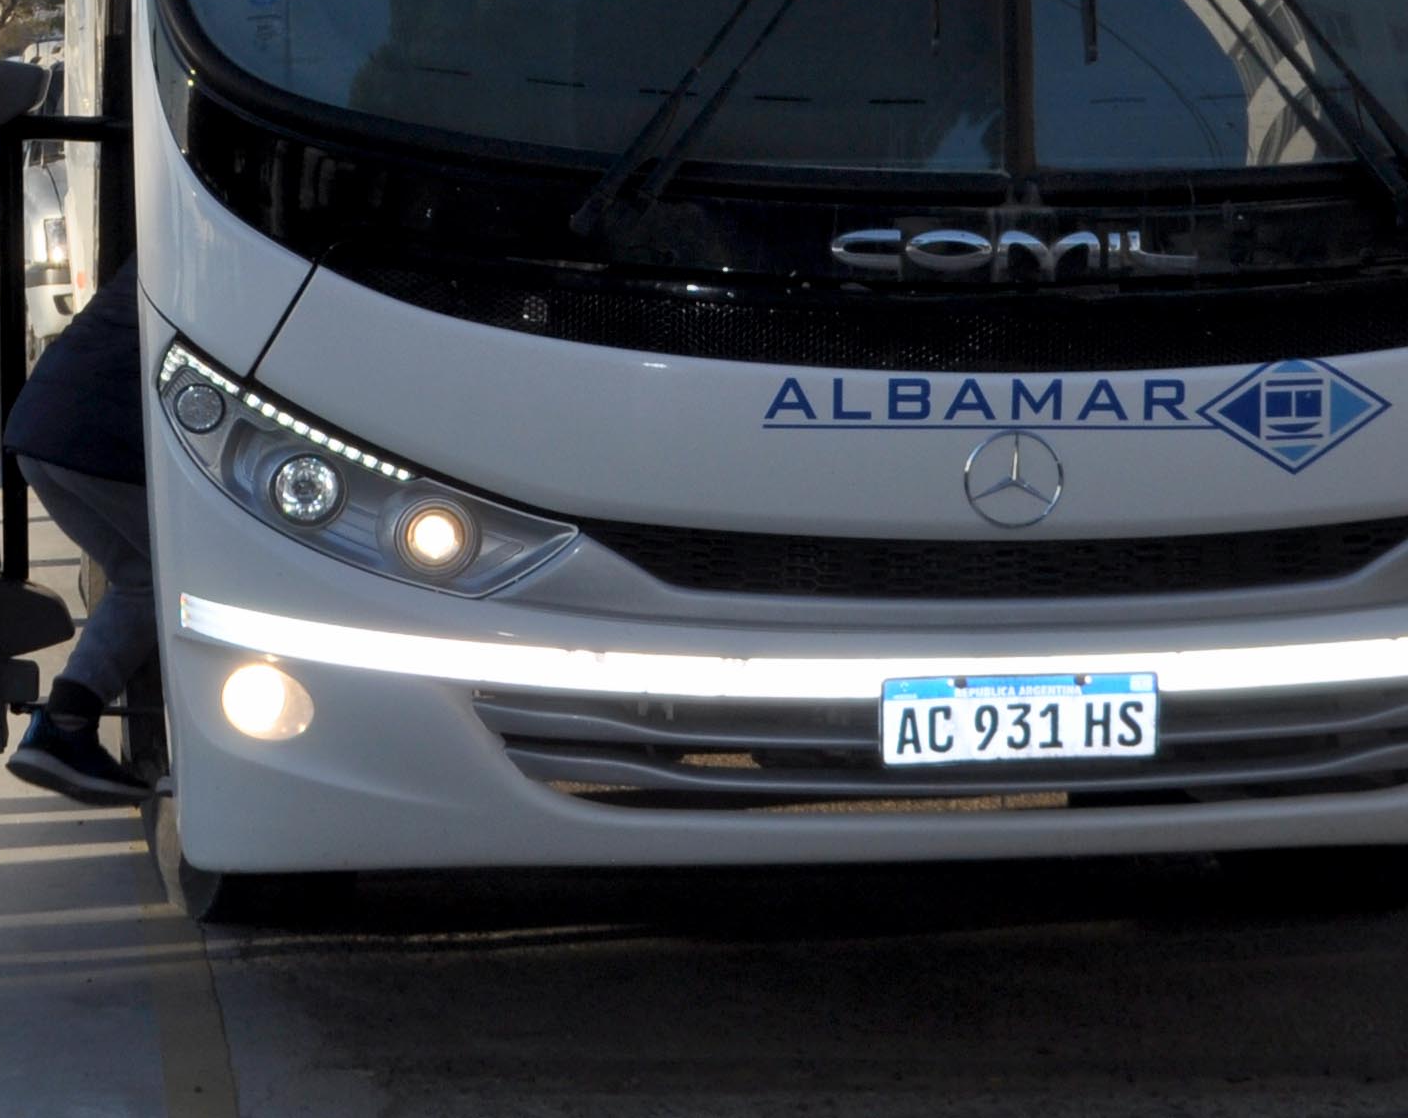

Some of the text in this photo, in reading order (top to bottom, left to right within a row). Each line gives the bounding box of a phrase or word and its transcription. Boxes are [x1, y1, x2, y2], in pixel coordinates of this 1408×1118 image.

[764, 377, 1191, 421] ALBAMAR
[1018, 684, 1083, 697] ARGENTINA
[896, 700, 1144, 755] AC 931 HS
